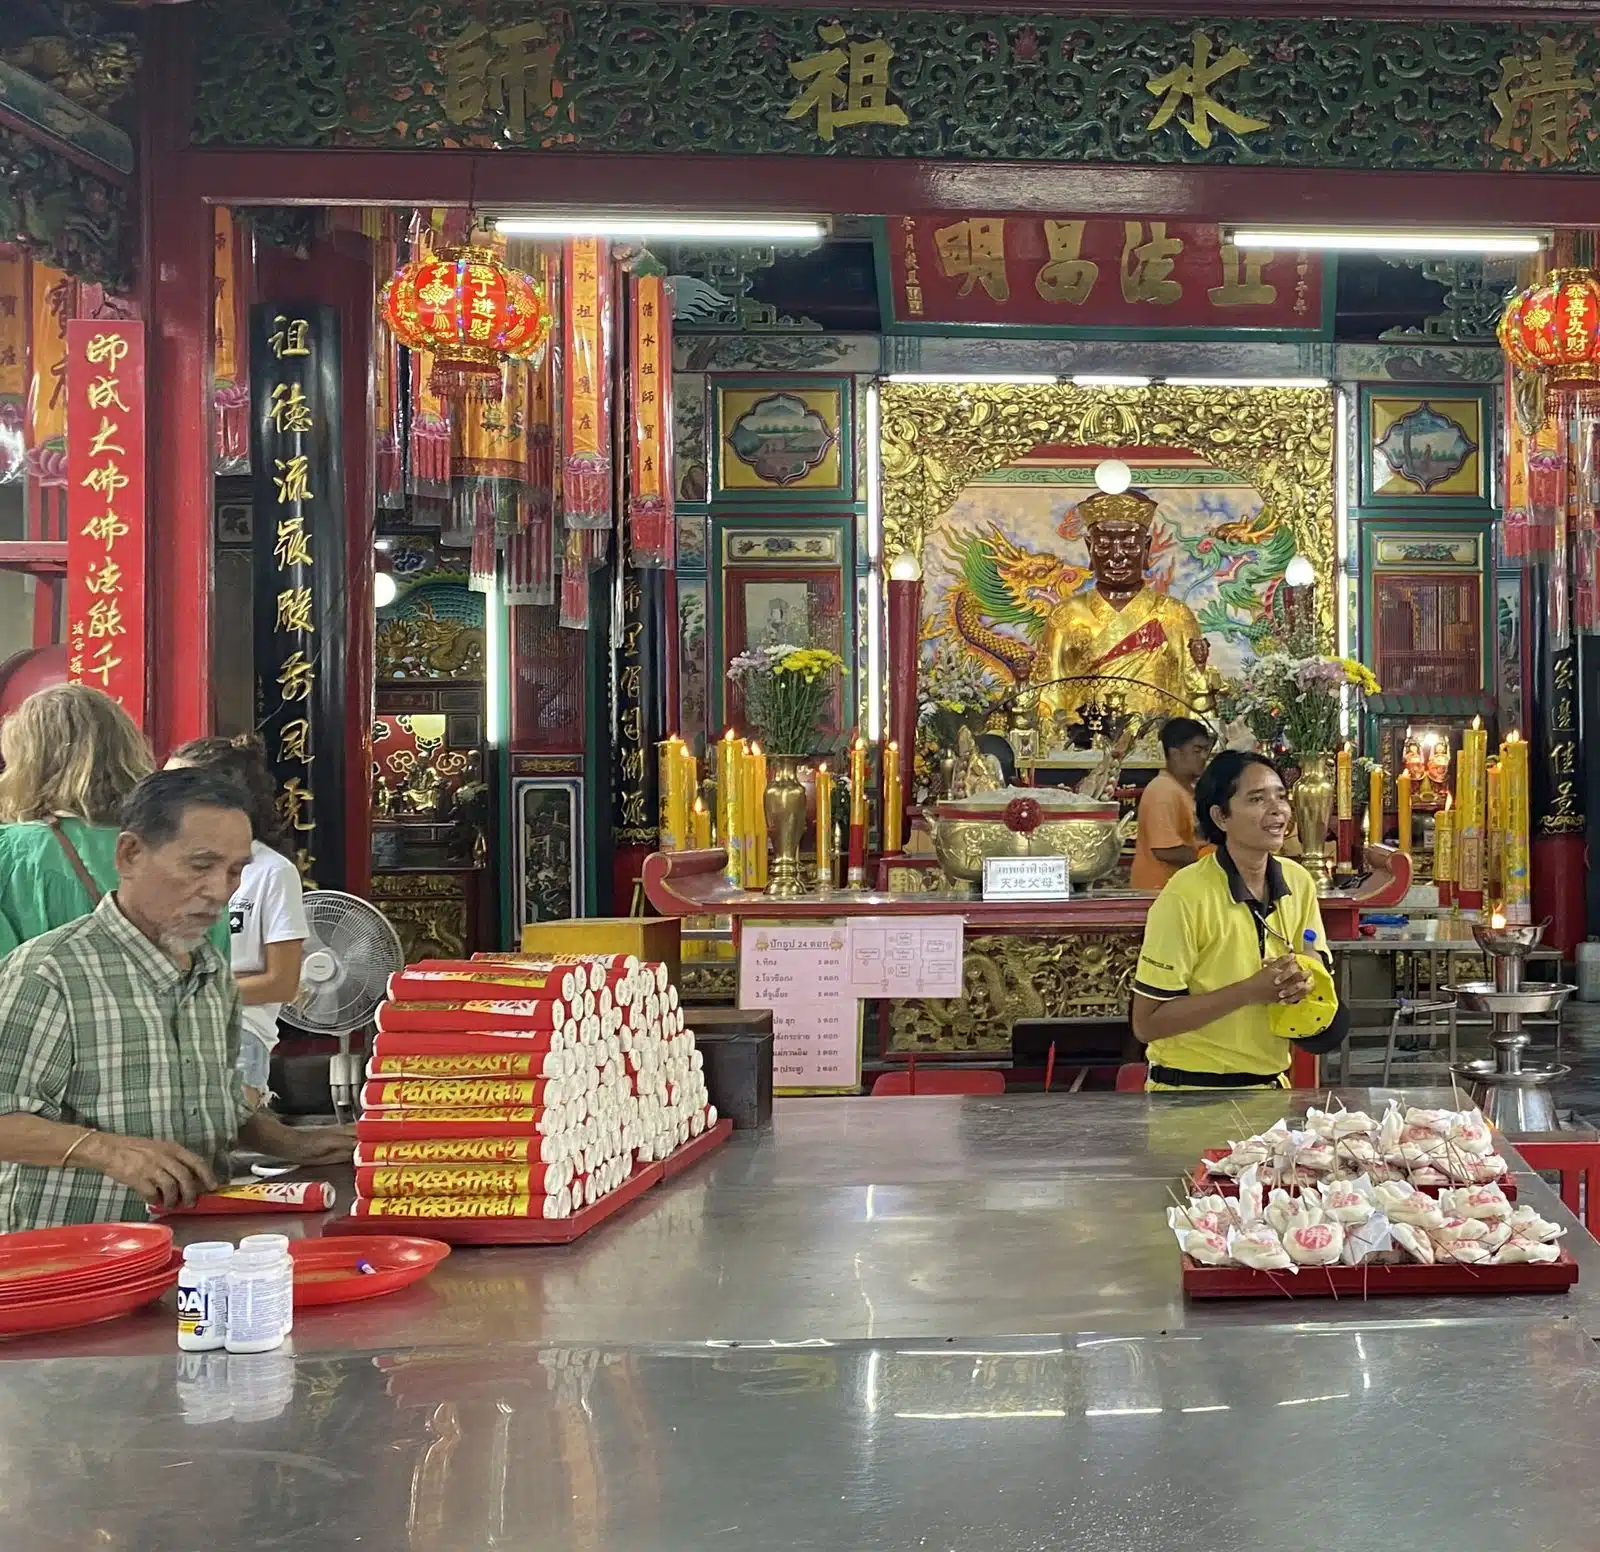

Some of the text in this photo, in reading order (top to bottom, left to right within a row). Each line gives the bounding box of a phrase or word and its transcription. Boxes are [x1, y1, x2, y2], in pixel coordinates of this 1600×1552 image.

[1564, 284, 1589, 352] 恭喜发财
[1000, 877, 1054, 889] 天地父母
[770, 938, 795, 951] ปักธูป
[810, 940, 829, 948] ดอก
[823, 1049, 838, 1057] ดอก
